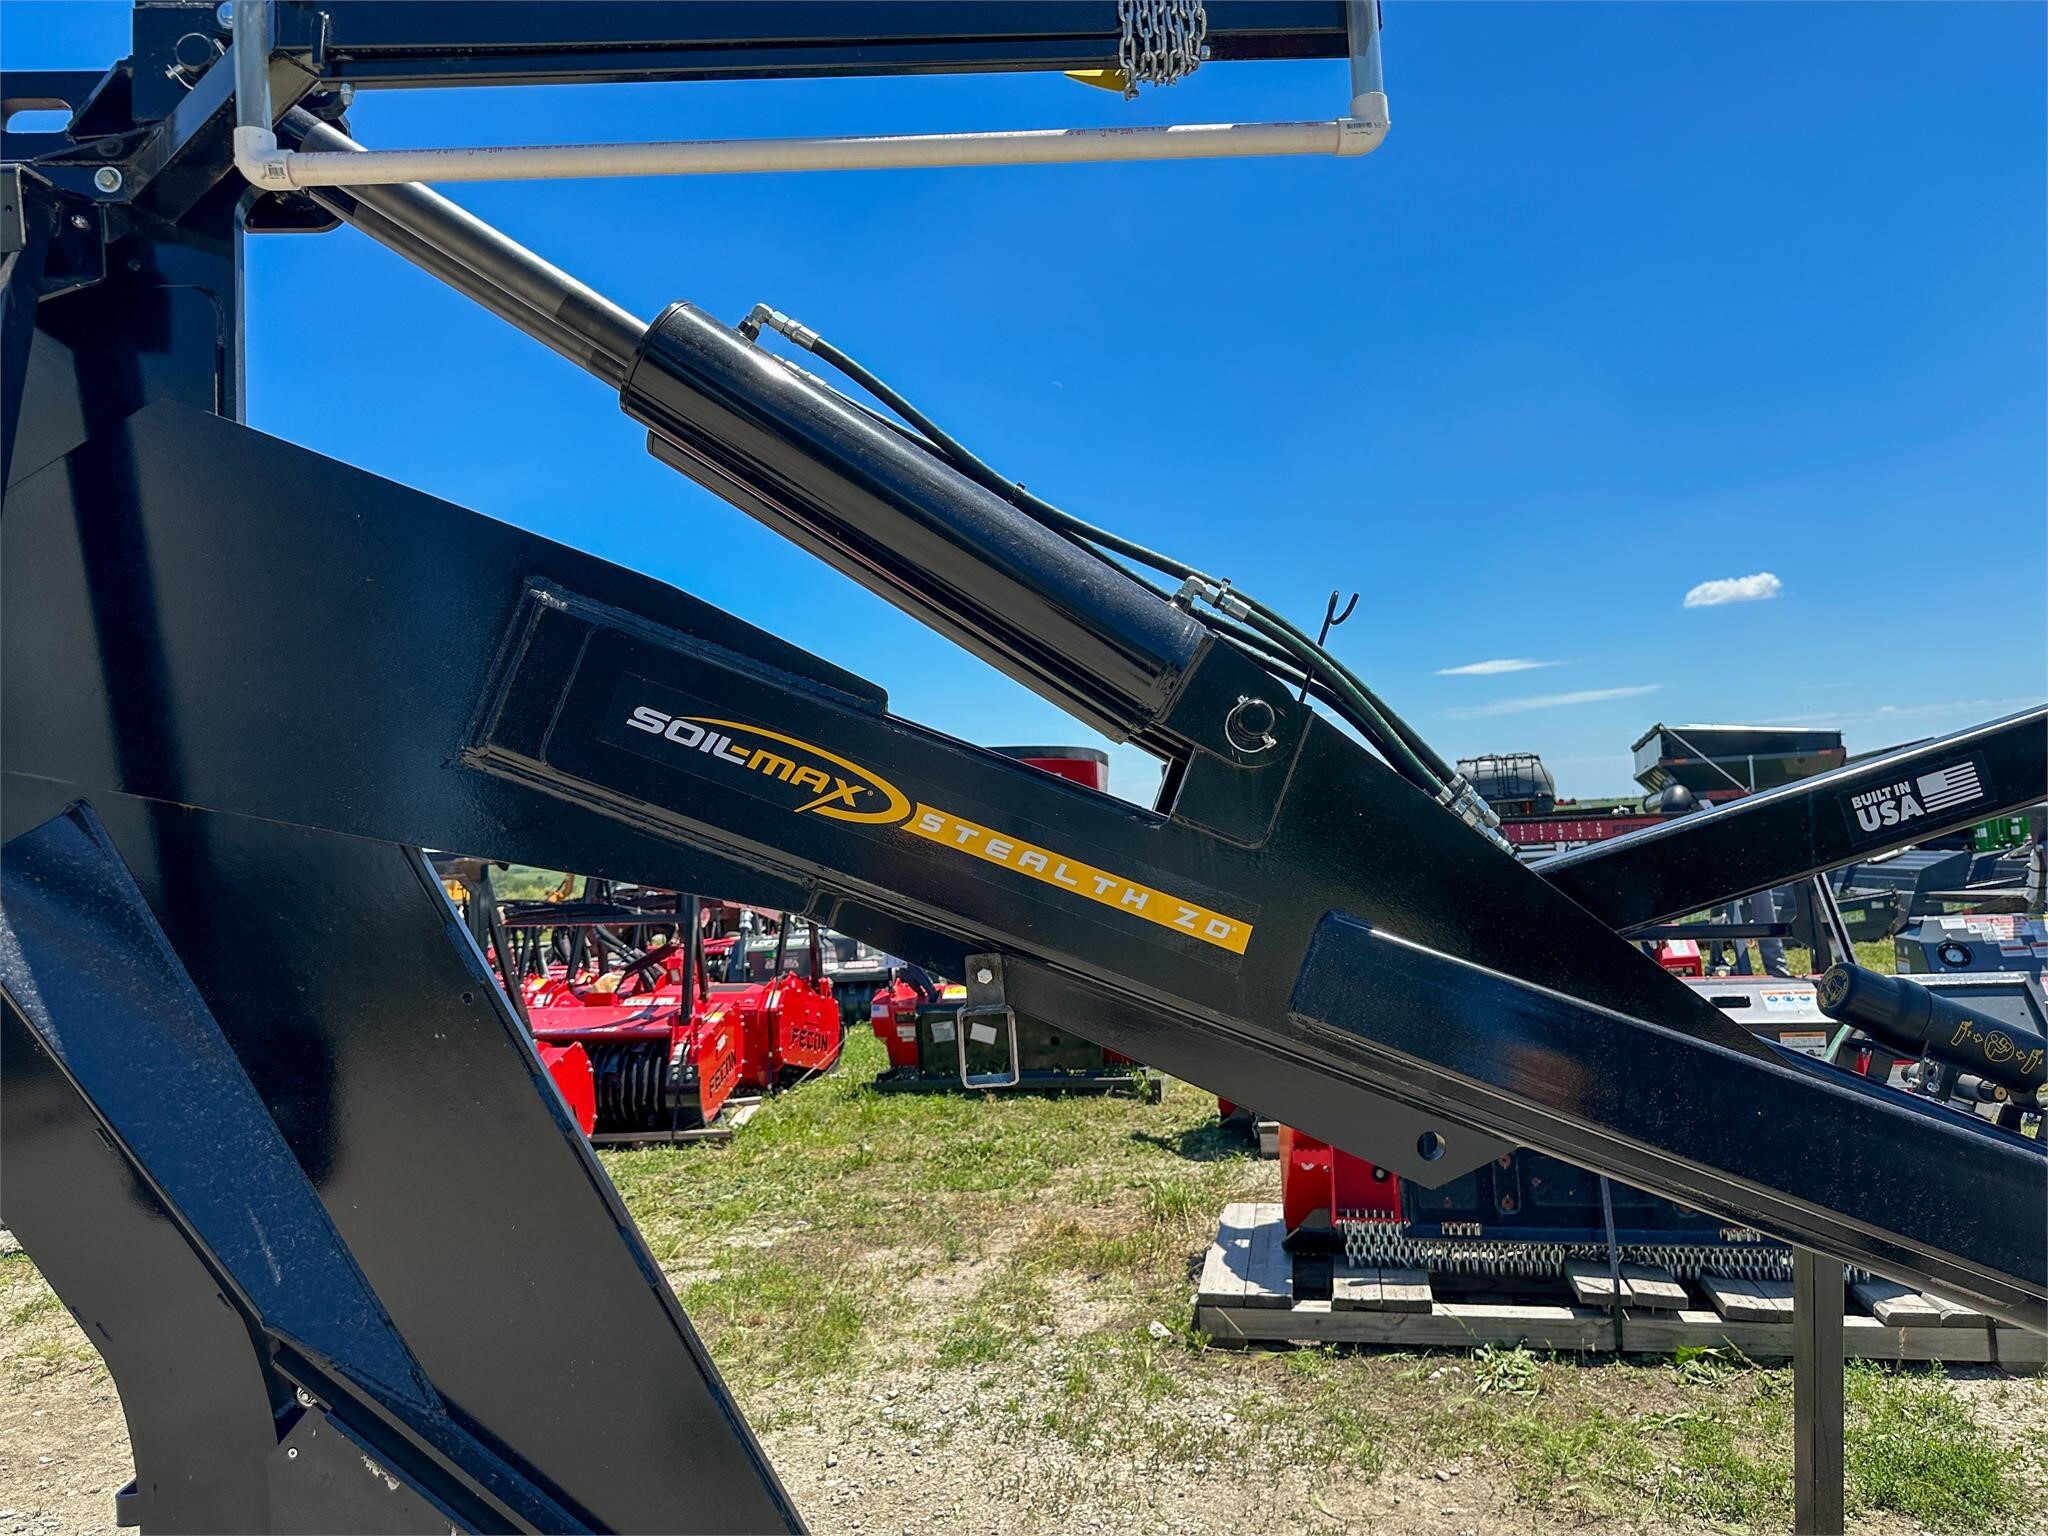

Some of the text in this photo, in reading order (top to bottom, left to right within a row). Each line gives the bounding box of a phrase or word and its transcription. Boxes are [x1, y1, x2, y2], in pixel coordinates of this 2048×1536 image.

[1851, 781, 1912, 809] BUILT IN
[1856, 795, 1925, 832] USA
[918, 813, 1149, 910] STEALTH
[792, 1027, 829, 1051] FECON
